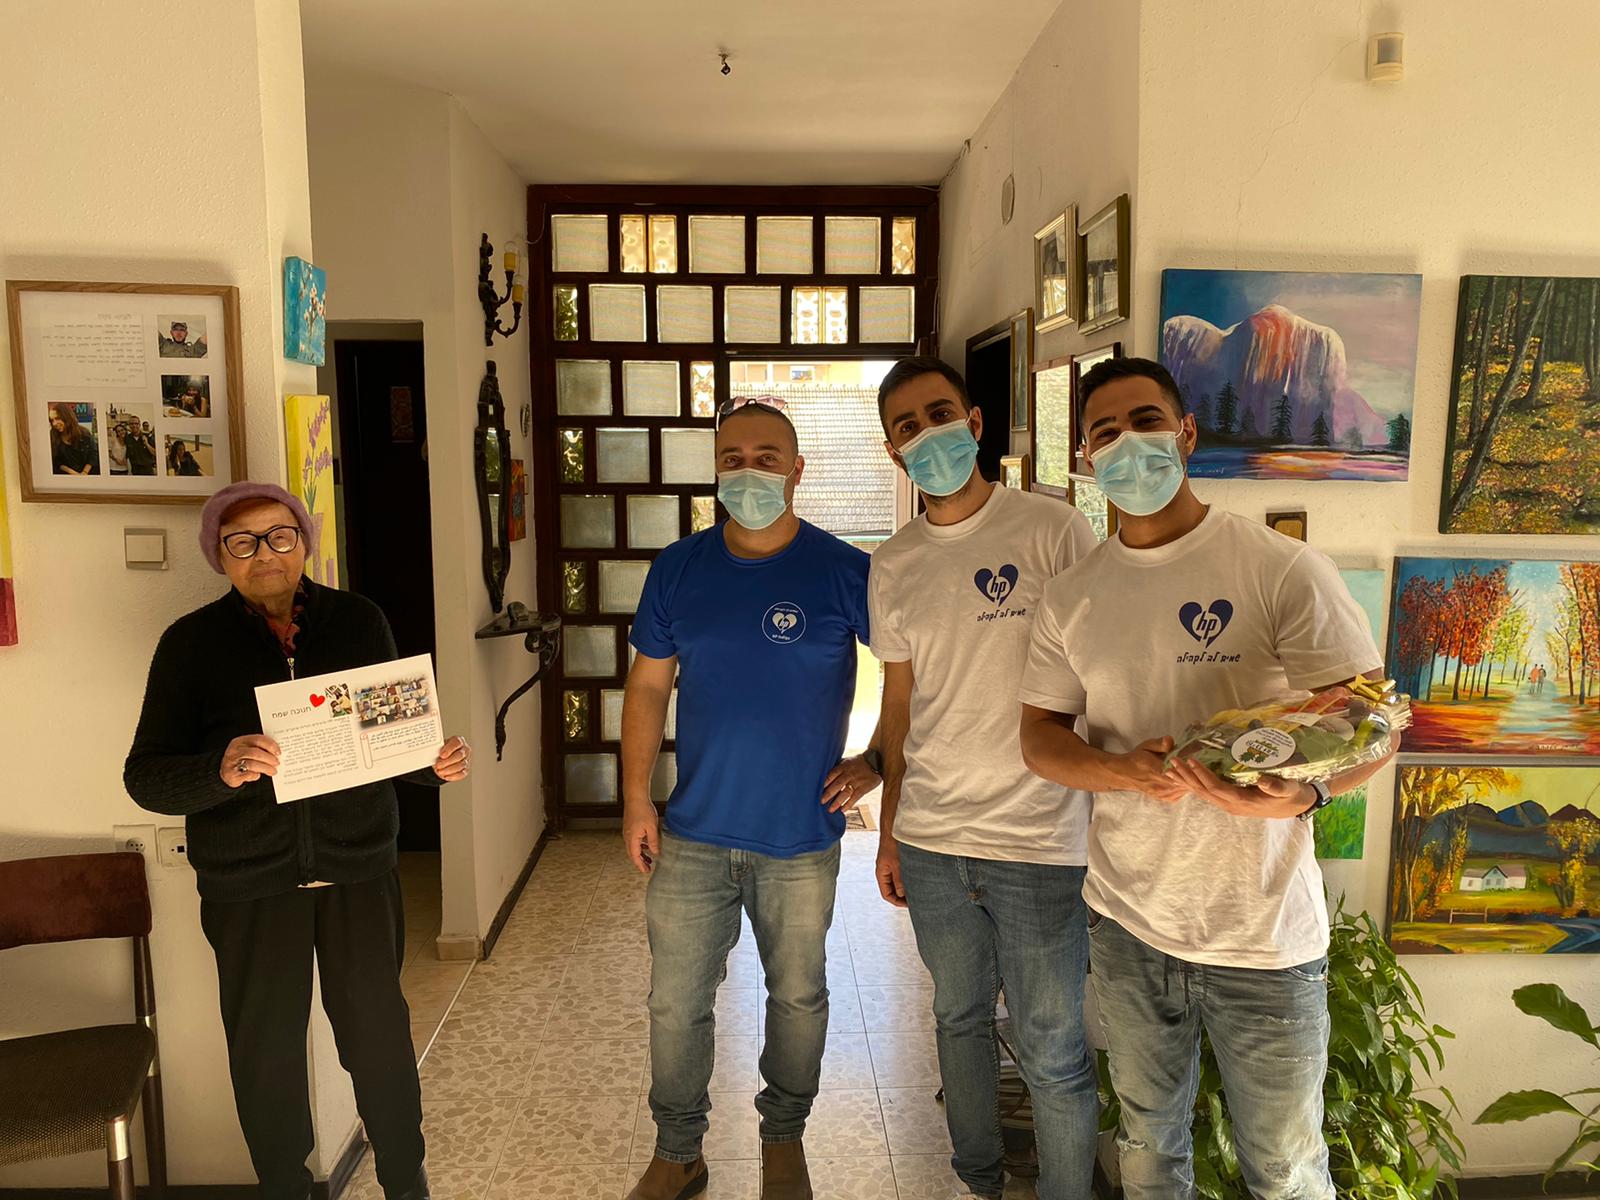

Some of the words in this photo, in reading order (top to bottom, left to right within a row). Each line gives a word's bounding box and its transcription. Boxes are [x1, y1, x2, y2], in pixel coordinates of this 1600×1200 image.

[990, 576, 1007, 600] hp
[1000, 608, 1010, 617] לב
[1196, 610, 1217, 640] hp
[1177, 652, 1207, 665] לקהילה
[1207, 652, 1220, 662] לב
[272, 710, 289, 719] שמח
[291, 706, 312, 715] חנוכה
